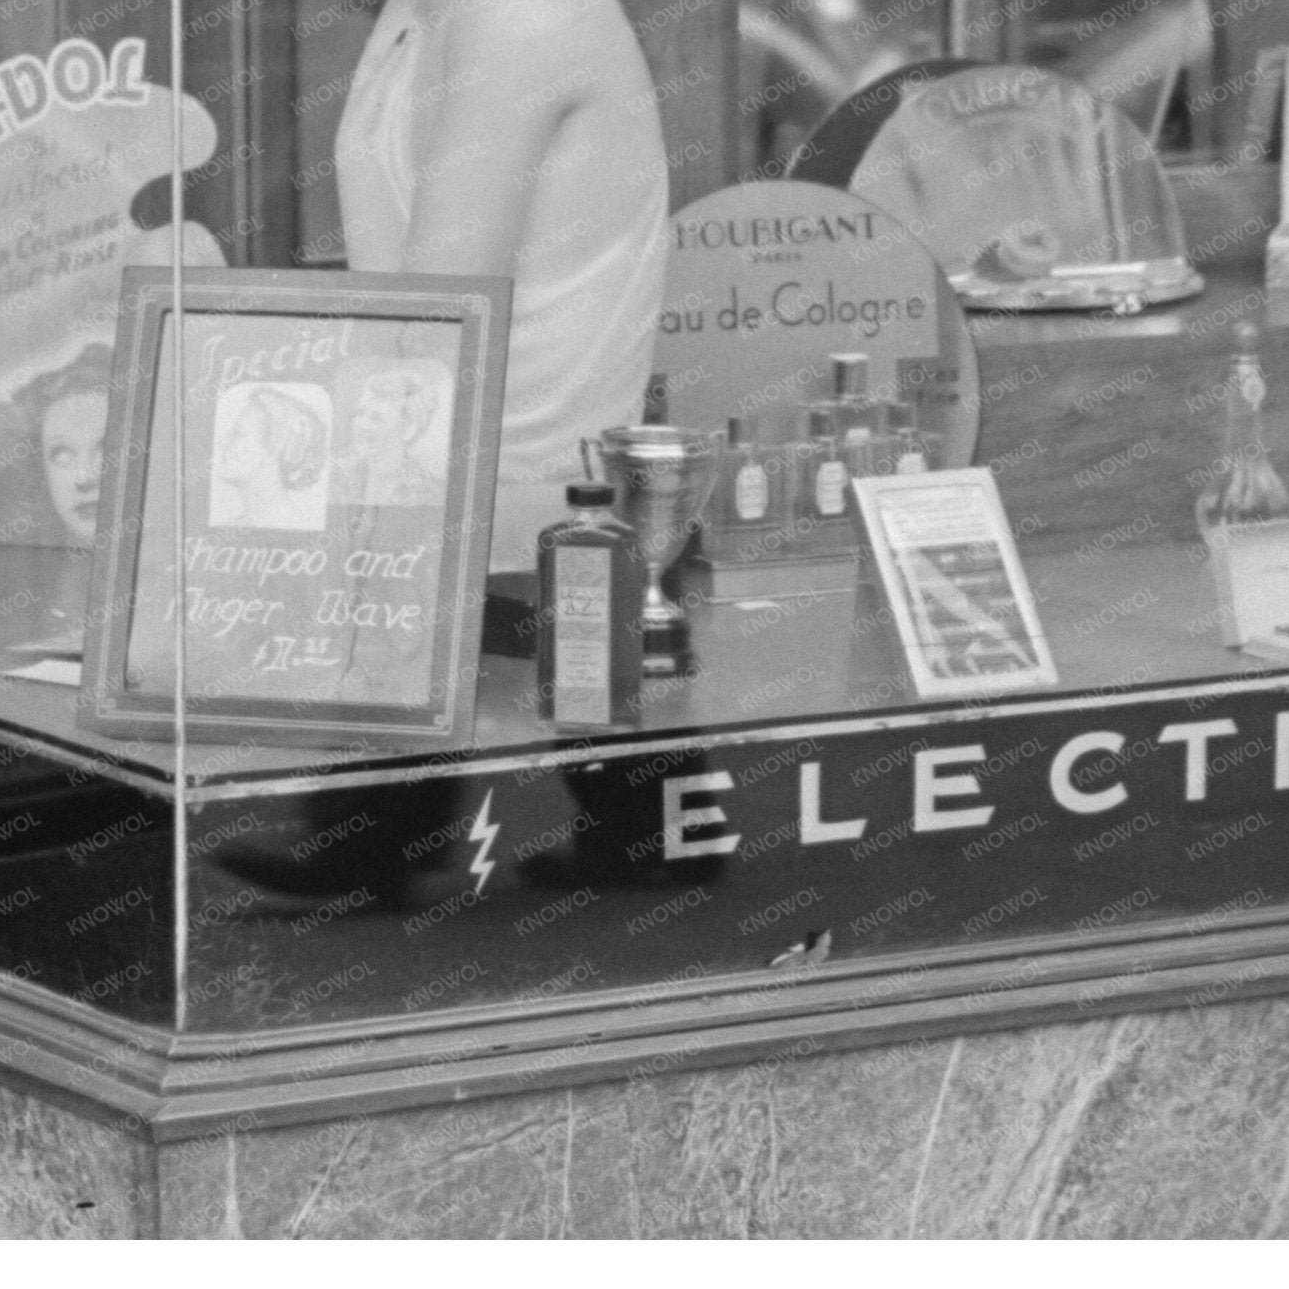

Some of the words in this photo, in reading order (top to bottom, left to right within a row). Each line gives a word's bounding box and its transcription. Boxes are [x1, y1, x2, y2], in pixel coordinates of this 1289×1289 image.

[676, 212, 878, 250] HOUBIGANT
[717, 287, 763, 331] de
[771, 281, 927, 337] Cologne
[192, 320, 352, 391] Special
[343, 543, 425, 580] and
[315, 589, 423, 630] Wave
